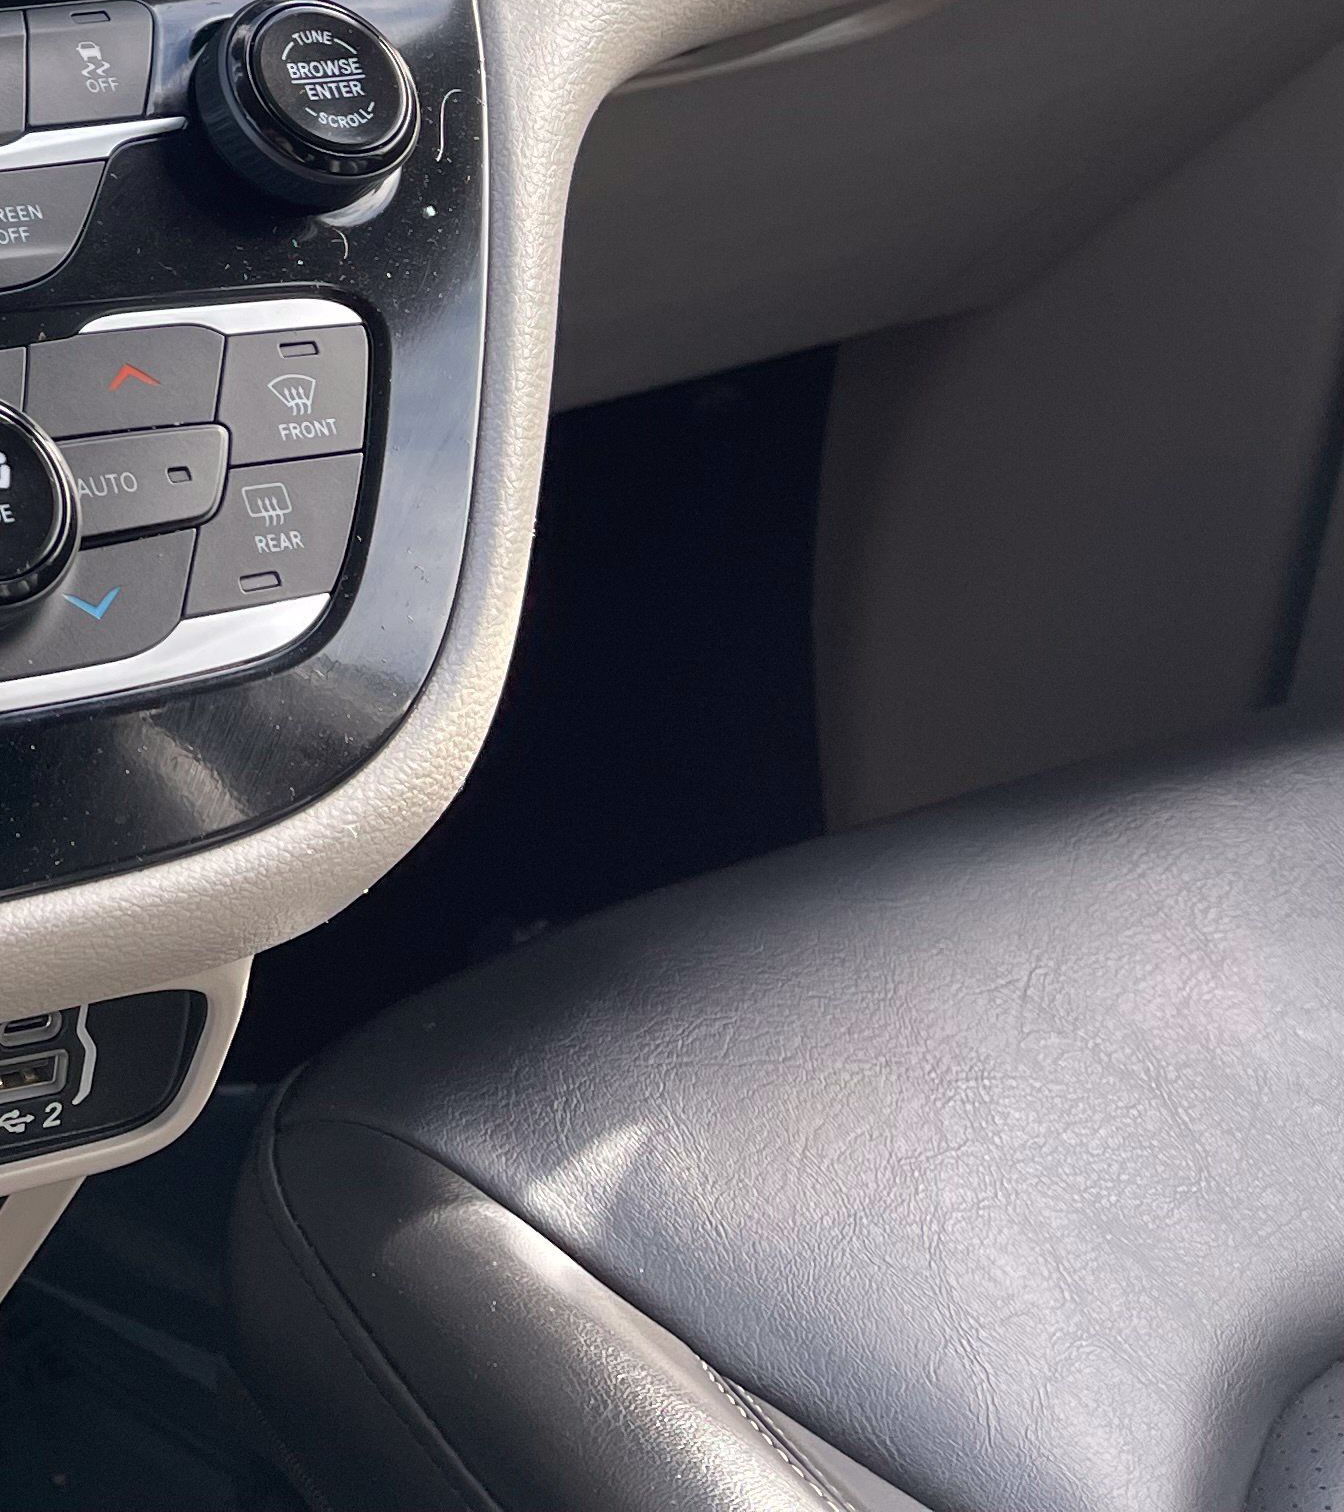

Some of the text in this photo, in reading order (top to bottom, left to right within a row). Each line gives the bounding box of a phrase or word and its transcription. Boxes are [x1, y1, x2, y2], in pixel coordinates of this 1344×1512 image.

[291, 29, 333, 45] TUNE
[285, 57, 364, 79] BROWSE
[86, 76, 120, 94] OFF
[303, 81, 365, 101] ENTER
[318, 107, 374, 130] SCROLL
[278, 418, 337, 441] FRONT
[76, 472, 138, 499] AUTO
[254, 530, 305, 553] REAR
[42, 1101, 63, 1128] 2
